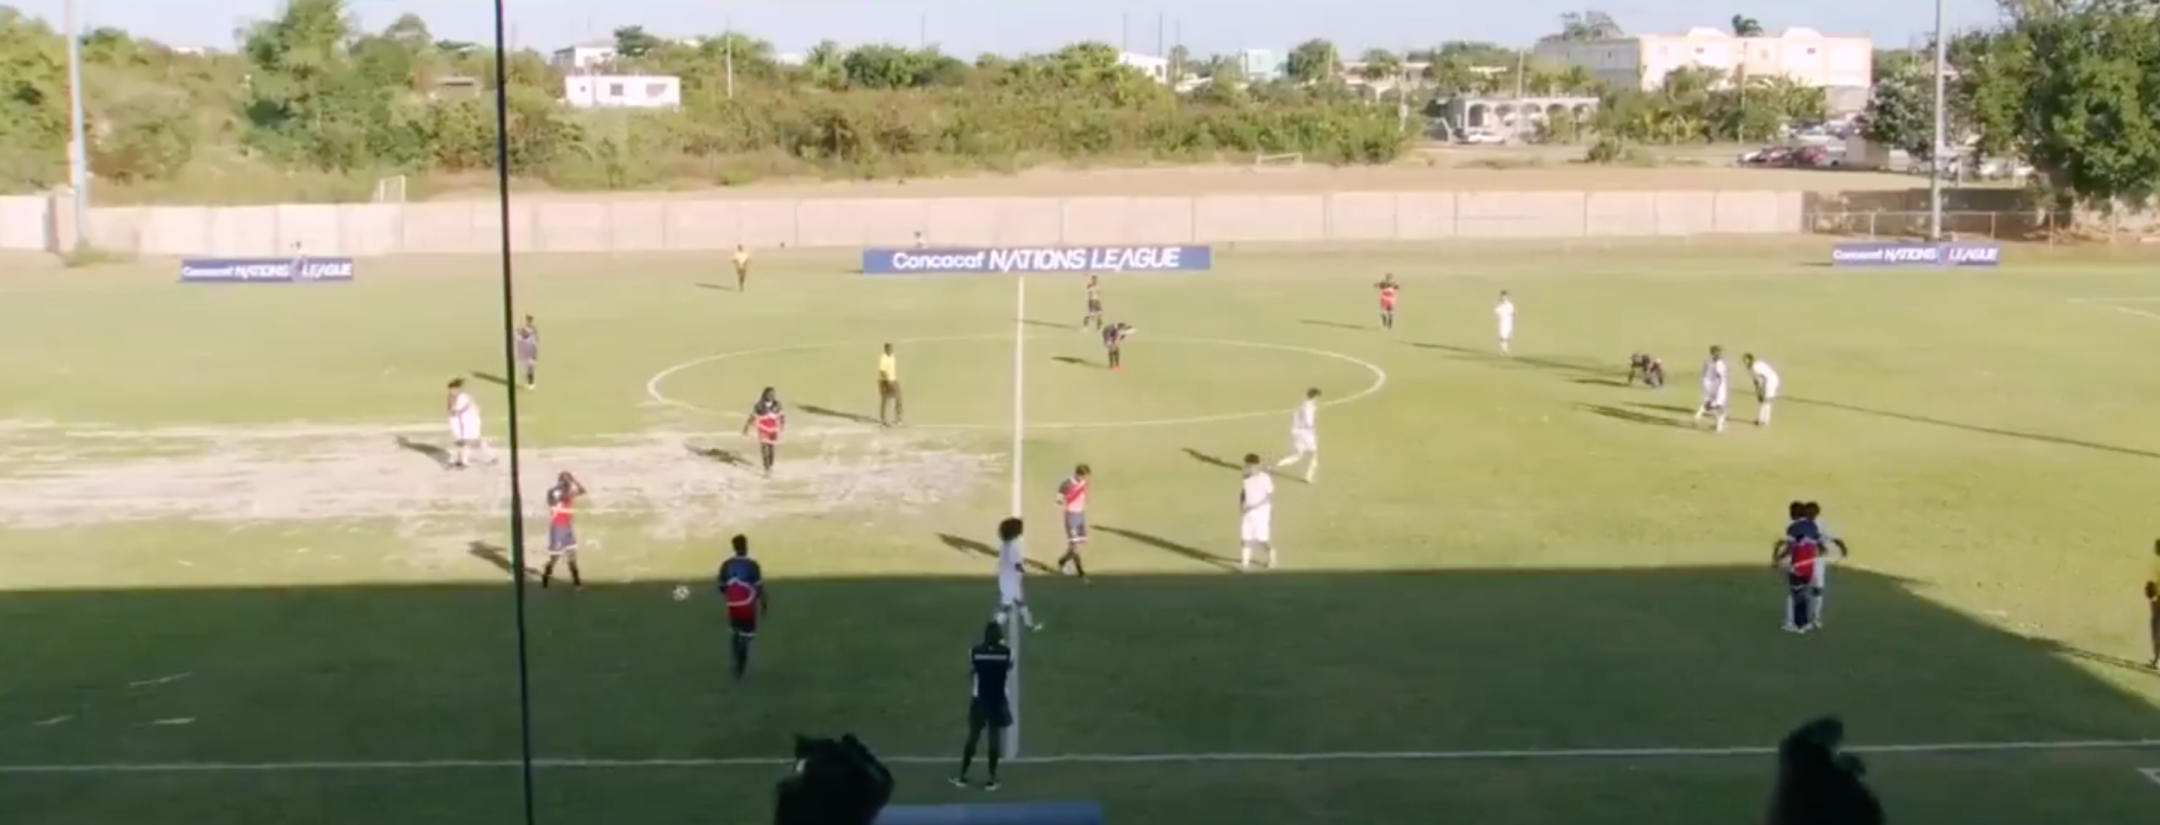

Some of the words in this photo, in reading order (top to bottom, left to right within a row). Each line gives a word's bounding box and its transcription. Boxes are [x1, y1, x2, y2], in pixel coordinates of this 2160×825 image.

[893, 251, 985, 270] Concacaf
[989, 249, 1087, 272] NATIONS
[1090, 247, 1181, 271] LEAGUE
